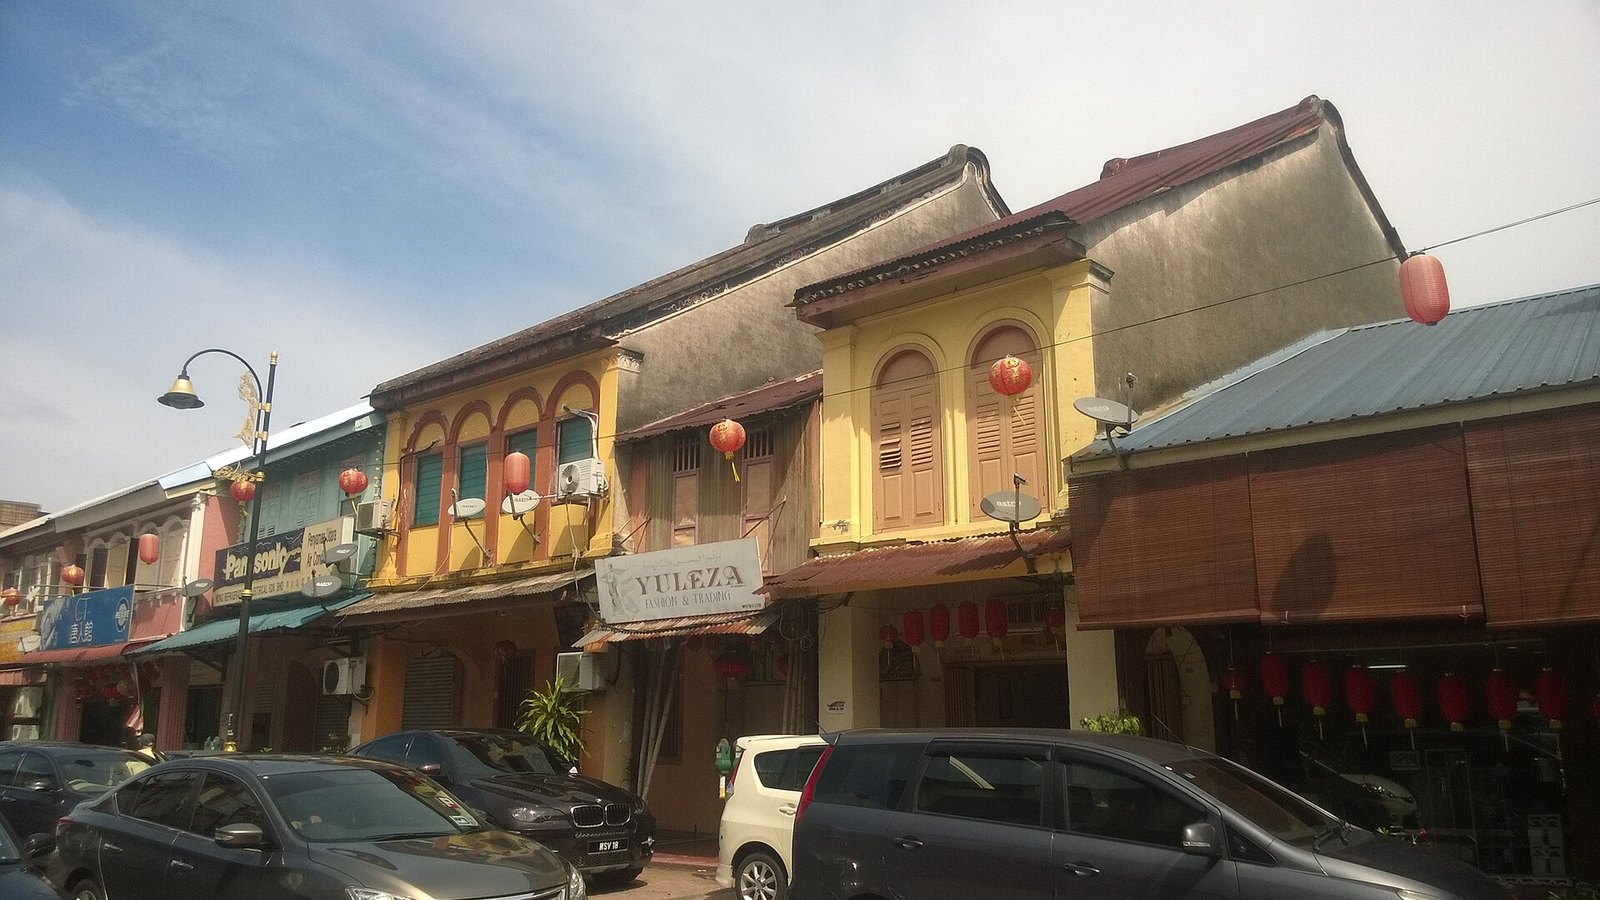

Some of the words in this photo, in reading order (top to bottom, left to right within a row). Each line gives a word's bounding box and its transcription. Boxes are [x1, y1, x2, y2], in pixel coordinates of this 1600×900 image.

[224, 542, 288, 581] Pansonic
[635, 565, 744, 595] YULEZA
[645, 596, 678, 609] FASHION
[682, 597, 690, 606] &
[692, 591, 731, 604] TRADING
[612, 840, 619, 850] 18
